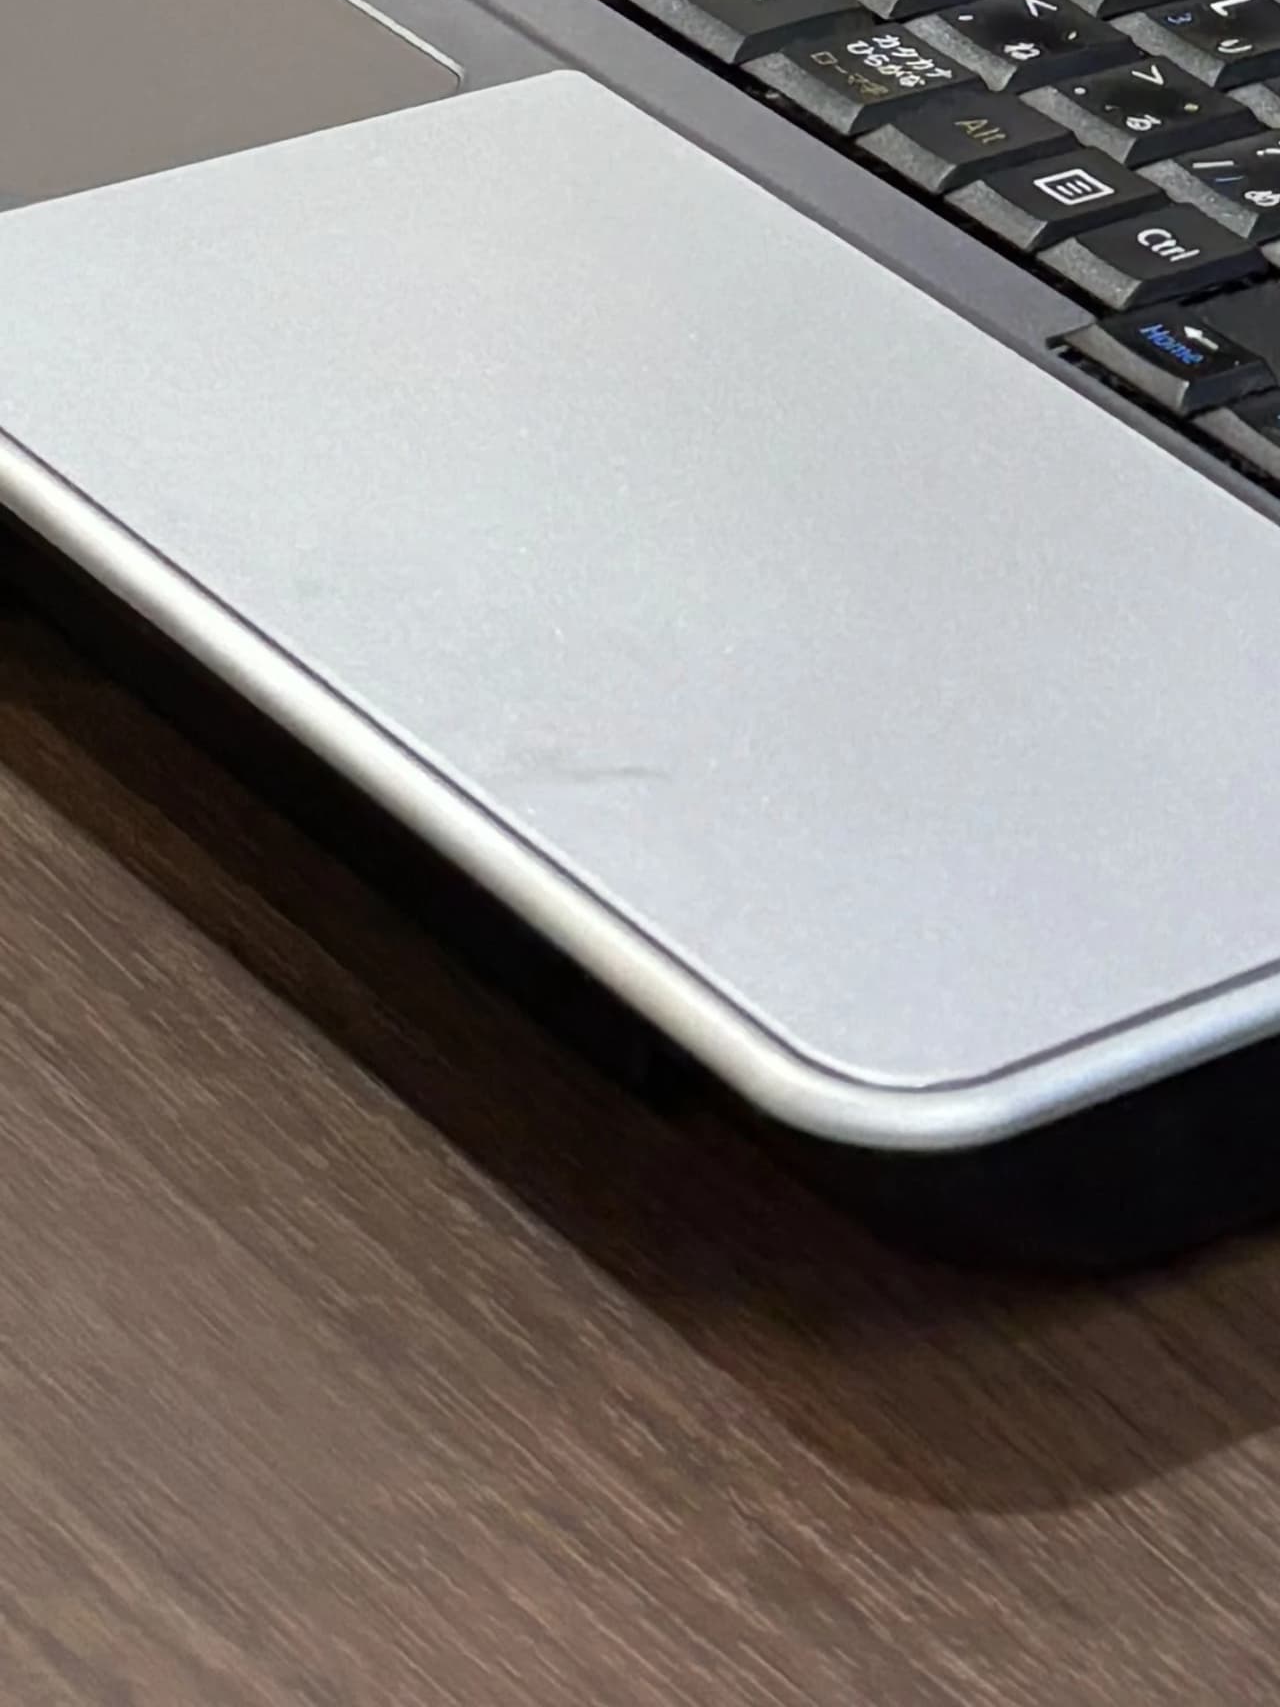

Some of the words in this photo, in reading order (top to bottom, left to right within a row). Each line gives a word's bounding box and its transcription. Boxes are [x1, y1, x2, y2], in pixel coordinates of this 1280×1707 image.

[954, 117, 1007, 144] Alt
[1137, 226, 1200, 262] Ctrl
[1139, 322, 1205, 367] Home
